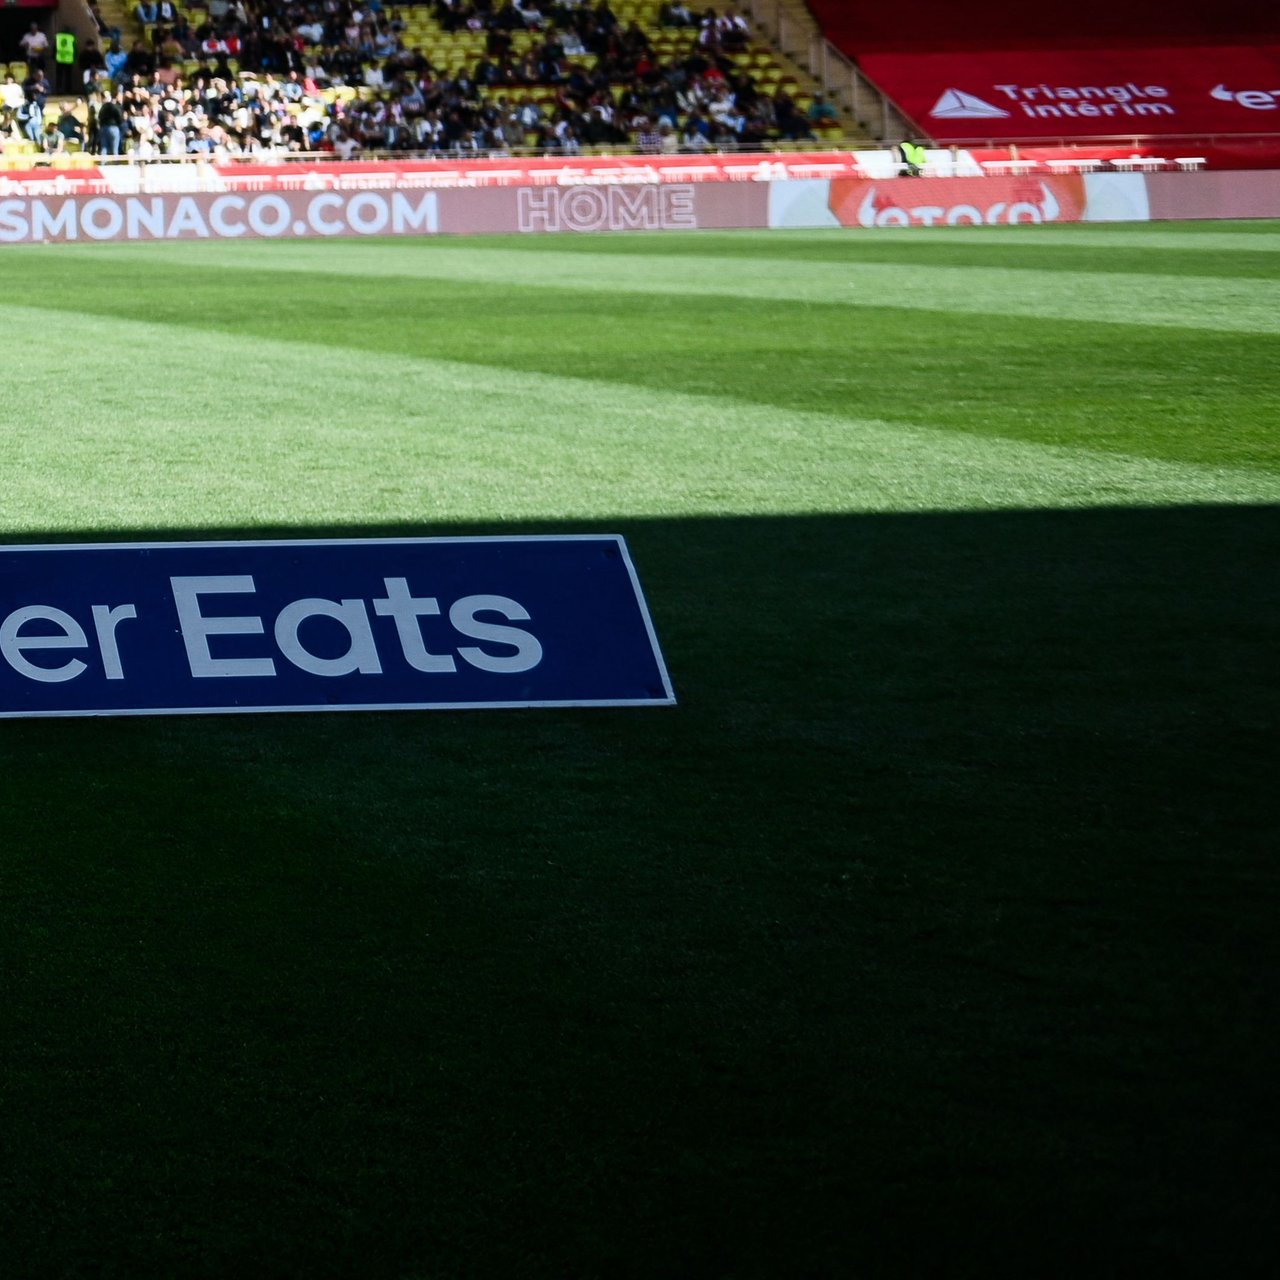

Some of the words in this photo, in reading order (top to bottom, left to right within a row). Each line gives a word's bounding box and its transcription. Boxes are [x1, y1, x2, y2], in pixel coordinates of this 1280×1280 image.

[994, 82, 1169, 103] Triangle
[1021, 99, 1175, 119] intérim
[516, 183, 697, 232] HOME
[169, 573, 545, 680] Eats
